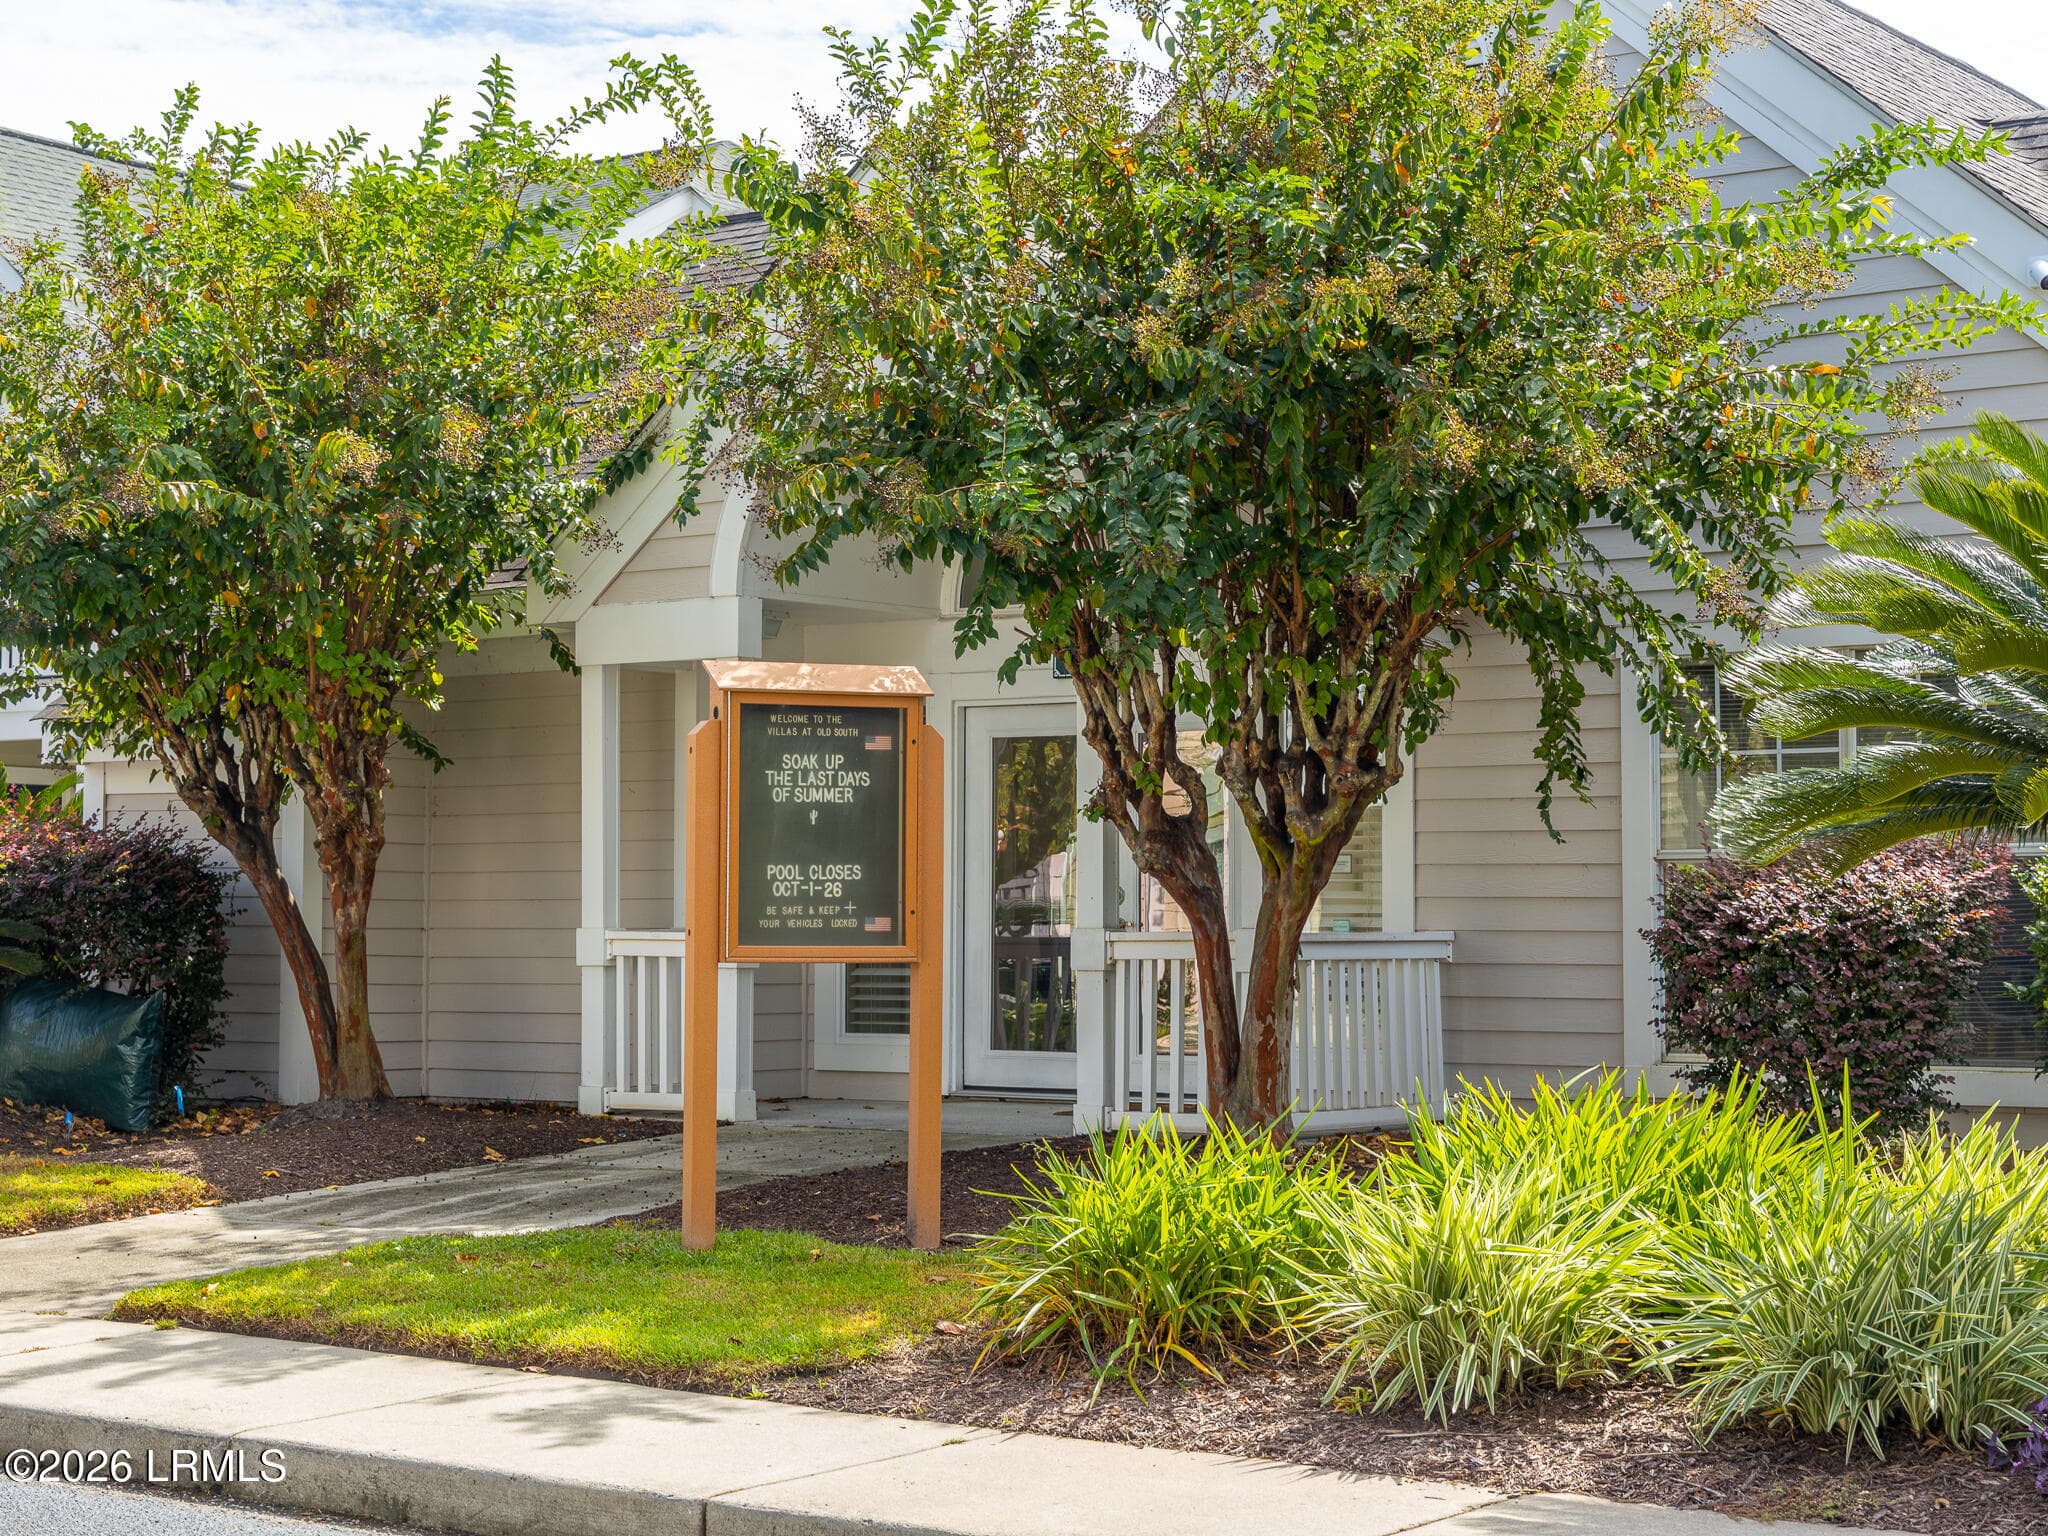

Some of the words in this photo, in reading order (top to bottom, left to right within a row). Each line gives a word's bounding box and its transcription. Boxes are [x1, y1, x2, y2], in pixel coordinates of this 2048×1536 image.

[770, 714, 809, 724] WELCOME
[814, 714, 823, 724] TO
[826, 715, 843, 724] THE
[767, 727, 798, 736] VILLAS
[802, 727, 812, 736] AT
[817, 727, 832, 737] OLD
[834, 728, 859, 737] SOUTH
[782, 754, 819, 769] SOAK
[825, 754, 844, 769] UP
[765, 770, 793, 786] THE
[798, 770, 835, 786] LAST
[838, 771, 871, 787] DAYS
[772, 787, 791, 803] OF
[794, 787, 854, 803] SUMMER
[767, 864, 804, 880] POOL
[809, 864, 862, 880] CLOSES
[766, 906, 777, 915] BE
[782, 906, 804, 915] SAFE
[819, 906, 841, 915] KEEP
[759, 919, 780, 928] YOUR
[786, 919, 823, 928] VEHICLES
[831, 919, 858, 928] LOCKED
